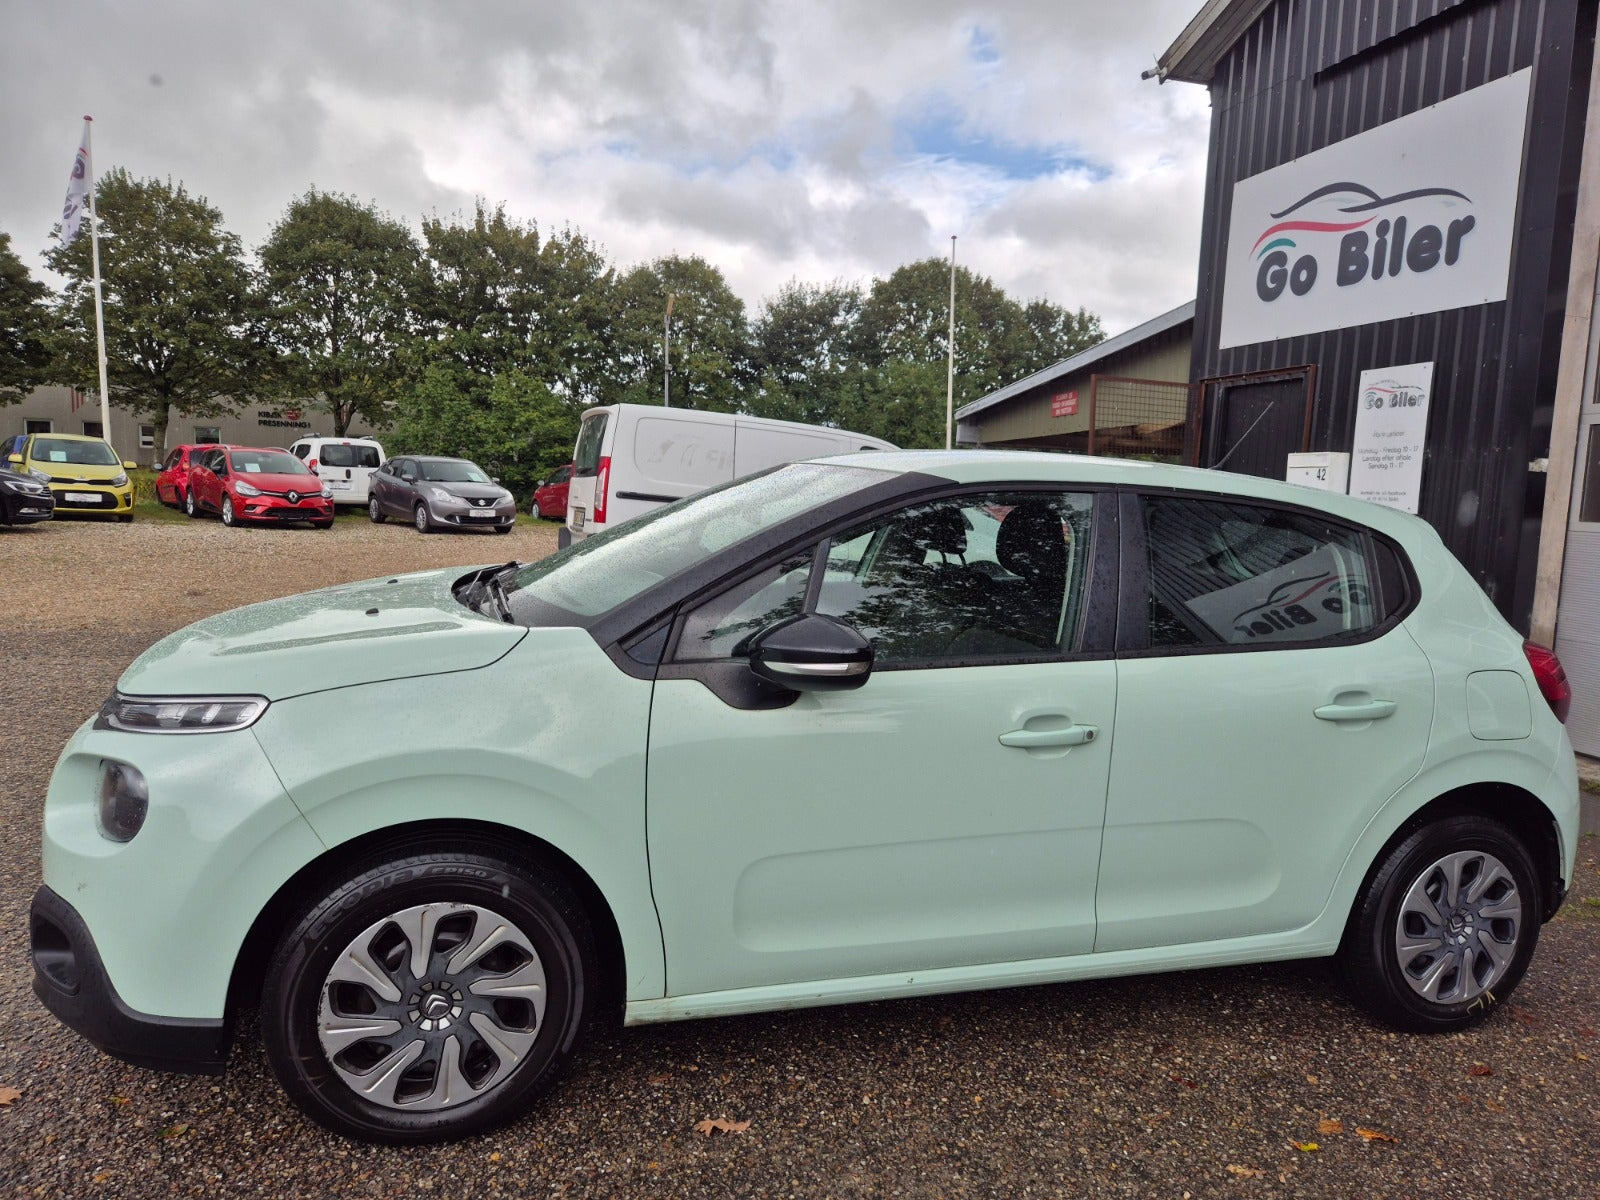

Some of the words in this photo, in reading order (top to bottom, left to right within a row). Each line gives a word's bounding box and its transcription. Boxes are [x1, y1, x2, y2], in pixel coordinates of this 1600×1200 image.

[1256, 250, 1318, 302] Go
[1336, 214, 1476, 287] Biler
[1364, 395, 1384, 410] Go
[1389, 391, 1426, 408] Biler
[1316, 468, 1327, 481] 42
